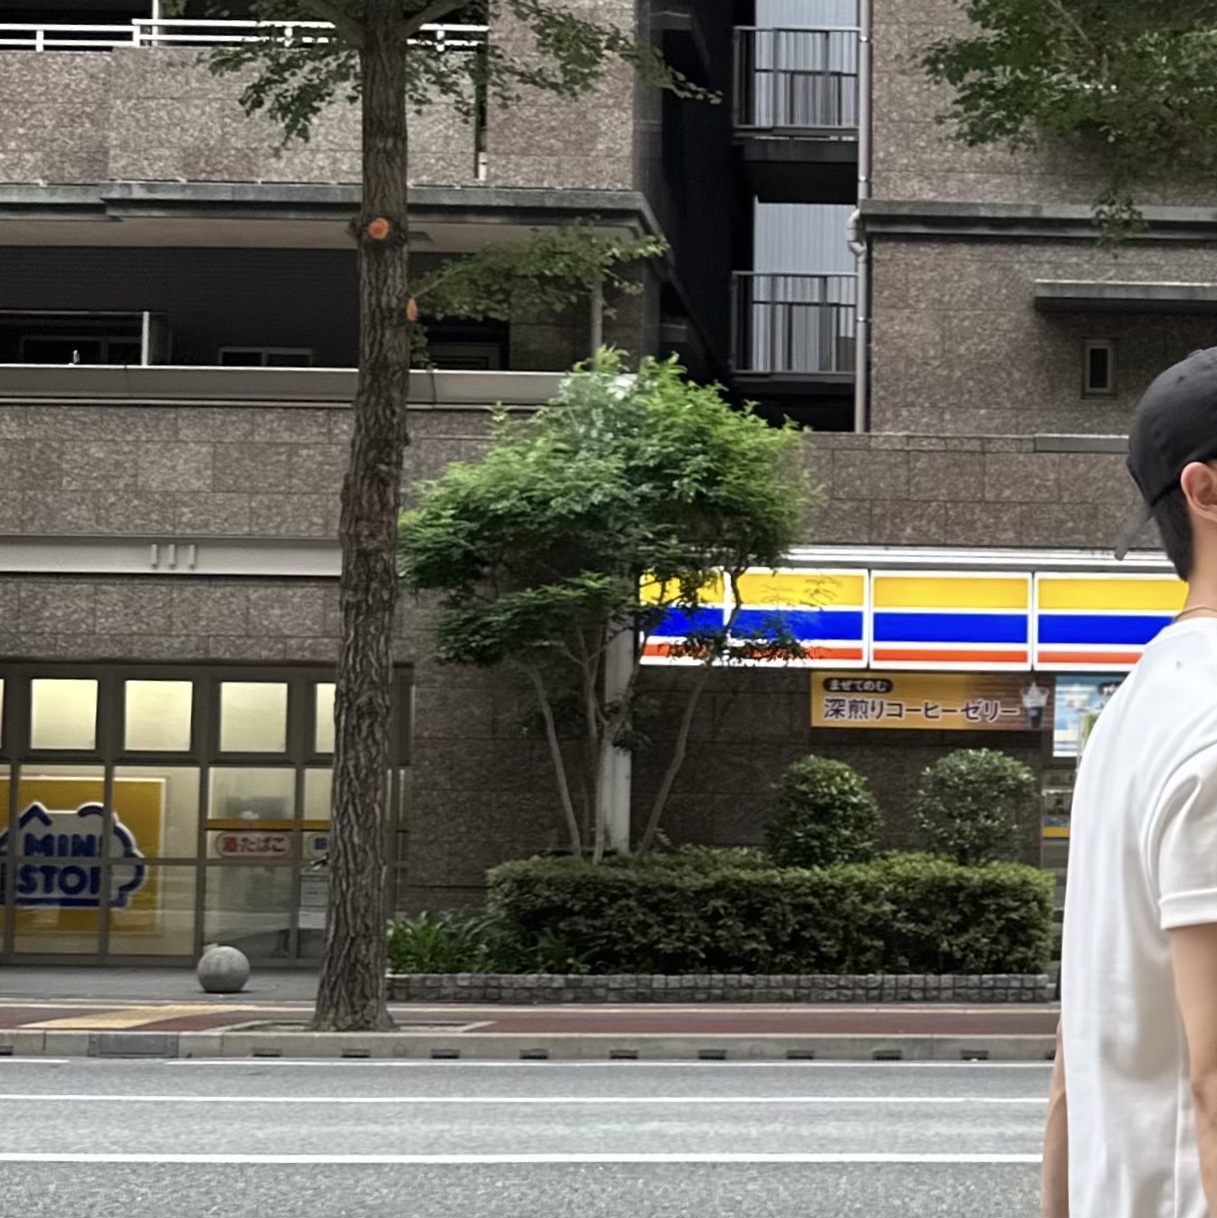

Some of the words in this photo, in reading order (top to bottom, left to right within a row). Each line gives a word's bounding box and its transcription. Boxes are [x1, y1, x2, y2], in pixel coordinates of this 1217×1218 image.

[829, 679, 887, 693] まぜてのむ
[823, 698, 1020, 722] 深煎りコーヒーゼリー
